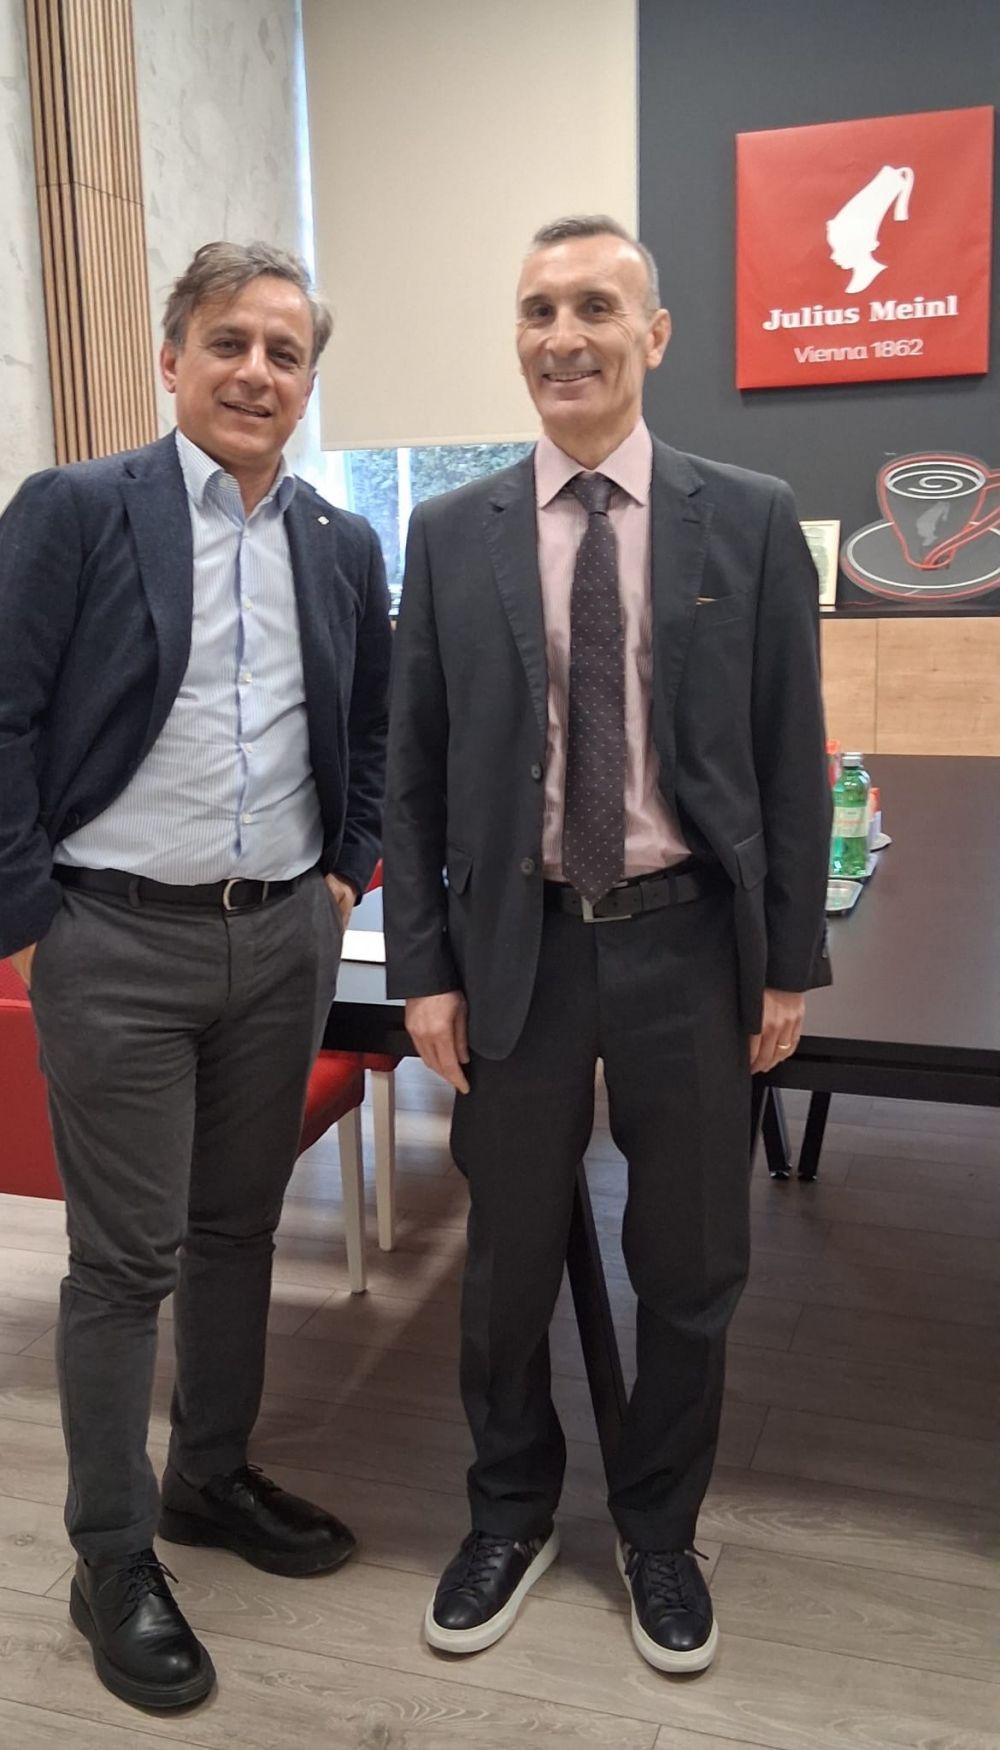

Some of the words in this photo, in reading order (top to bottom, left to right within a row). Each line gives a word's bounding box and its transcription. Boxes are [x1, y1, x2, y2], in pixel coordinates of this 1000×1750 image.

[762, 305, 860, 331] Julius
[869, 295, 958, 322] Meinl
[794, 345, 868, 363] Vienna
[870, 338, 924, 358] 1862
